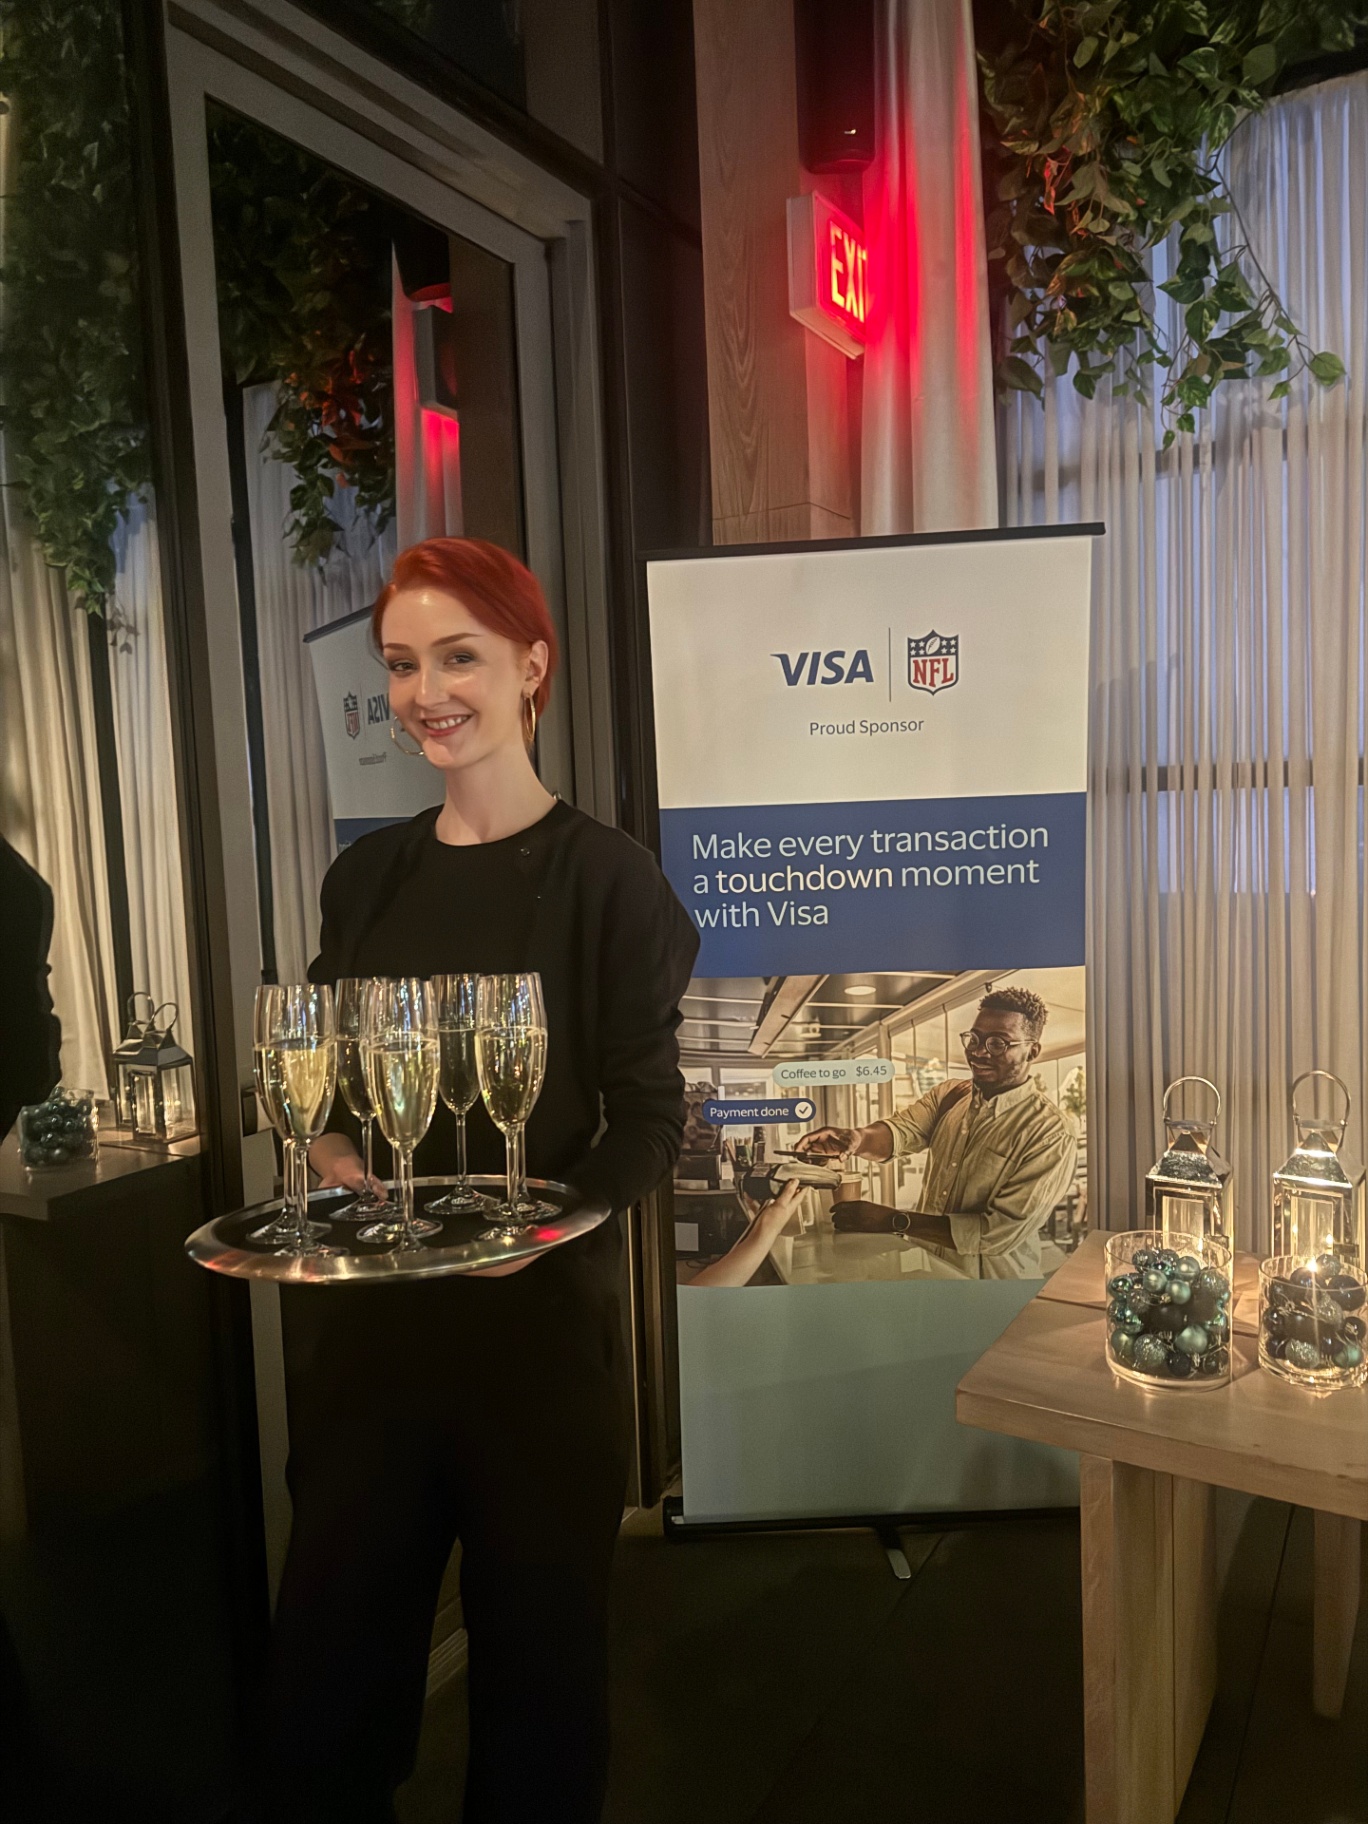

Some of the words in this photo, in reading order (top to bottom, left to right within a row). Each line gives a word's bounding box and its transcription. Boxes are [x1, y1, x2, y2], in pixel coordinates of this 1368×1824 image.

[829, 220, 867, 323] EXI
[770, 650, 874, 686] VISA
[913, 657, 954, 687] NFL
[809, 719, 856, 736] Proud
[859, 717, 924, 736] Sponsor
[692, 832, 772, 860] Make
[778, 834, 864, 861] every
[870, 823, 1049, 853] transaction
[693, 876, 709, 894] a
[715, 863, 893, 893] touchdown
[901, 859, 1040, 887] moment
[694, 901, 760, 928] with
[767, 899, 829, 926] Visa
[781, 1068, 816, 1080] Coffee
[818, 1068, 831, 1078] to
[833, 1069, 846, 1080] go
[856, 1065, 887, 1077] $6.45
[710, 1106, 759, 1120] Payment
[761, 1106, 789, 1117] done
